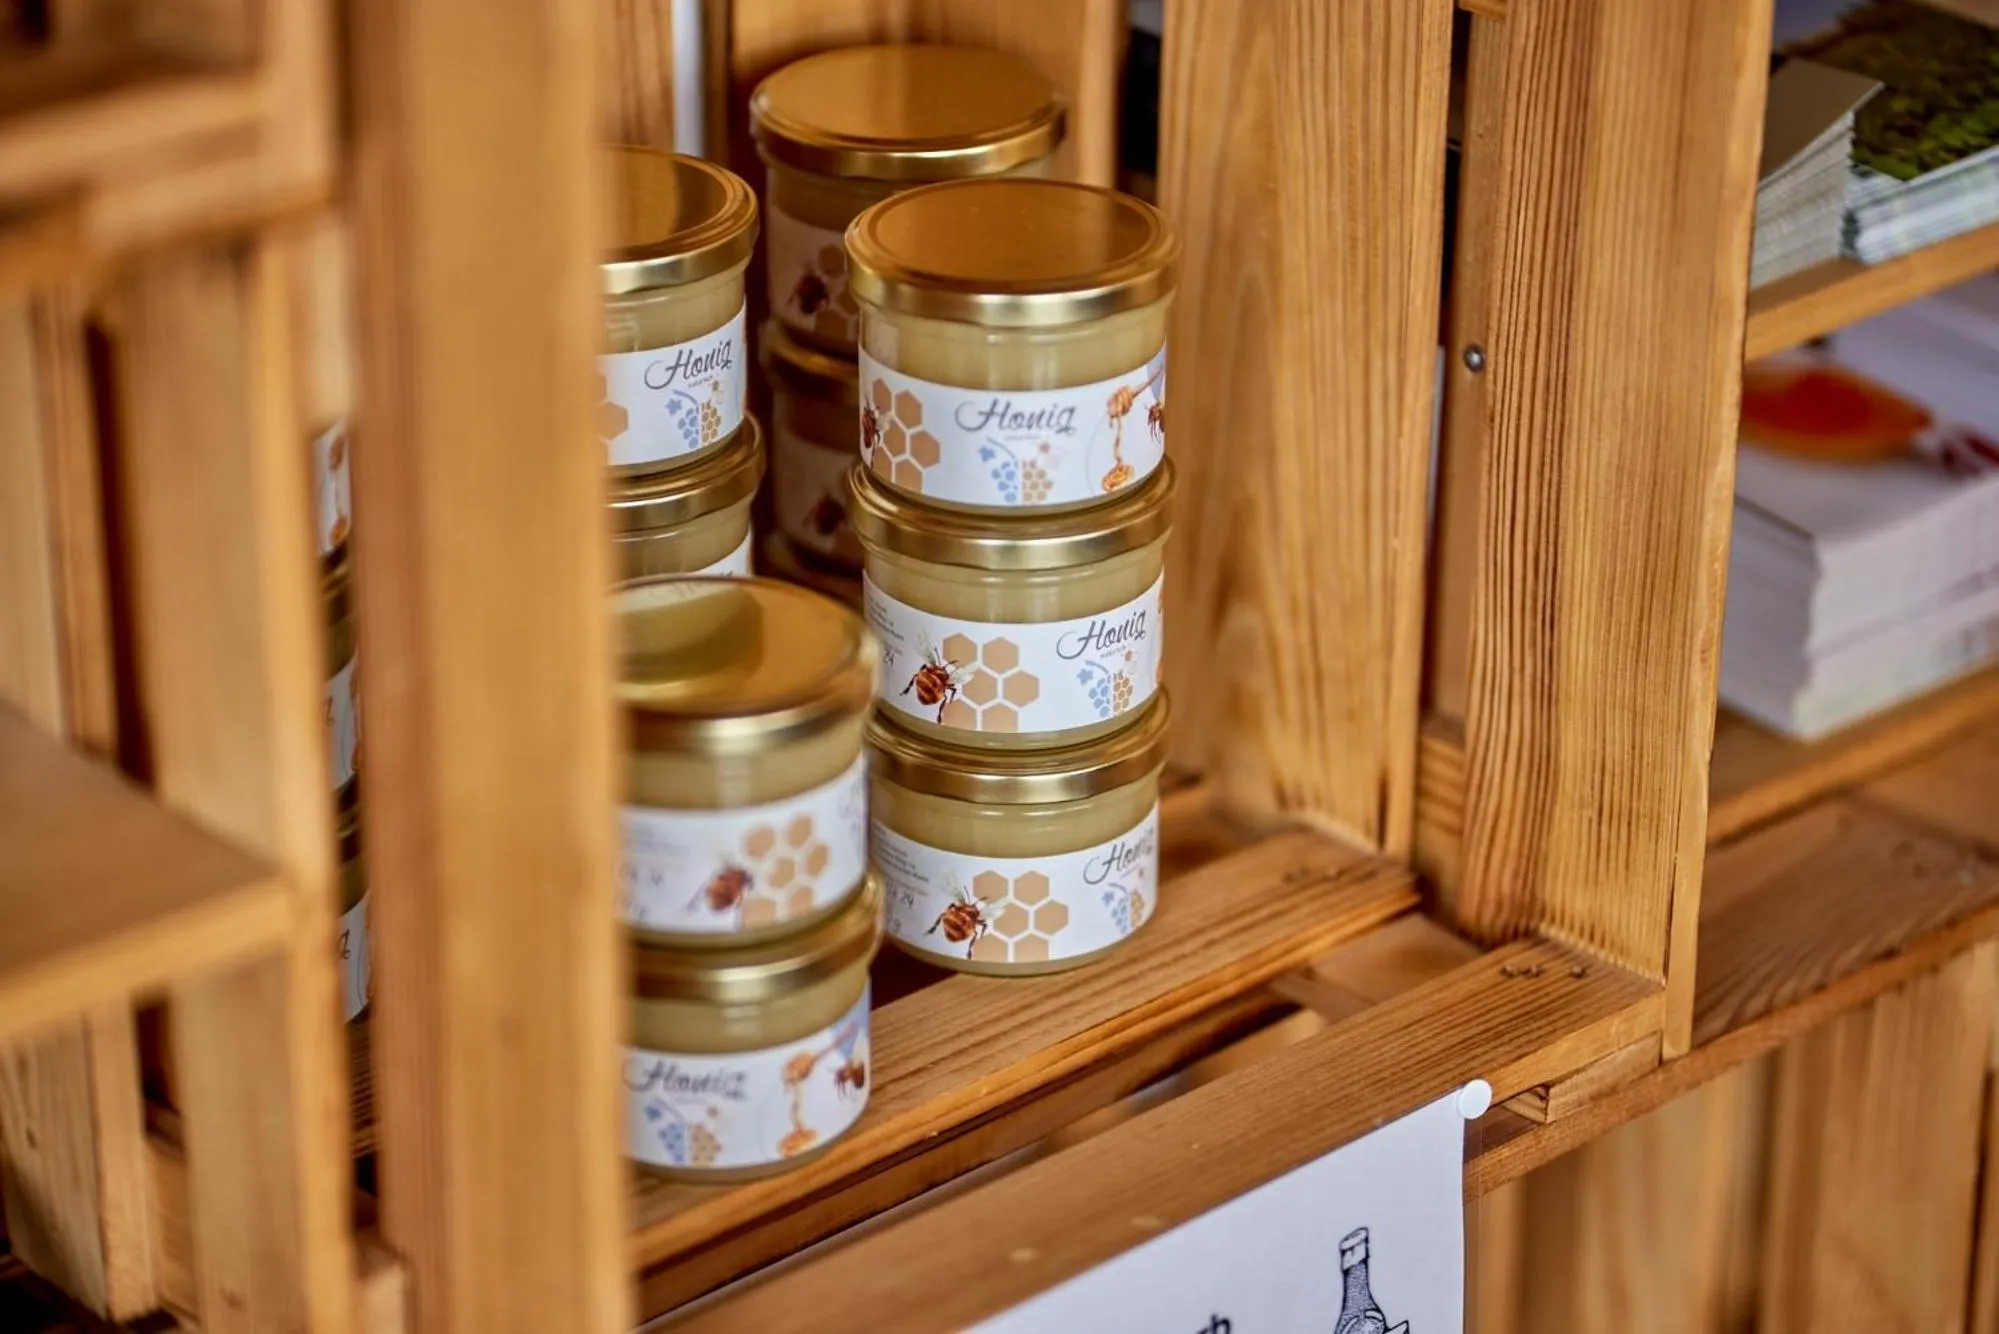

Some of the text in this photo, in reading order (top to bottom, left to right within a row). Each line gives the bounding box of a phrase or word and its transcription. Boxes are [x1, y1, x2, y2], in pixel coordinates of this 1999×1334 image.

[645, 339, 732, 390] Honig
[954, 397, 1077, 434] Honig
[1056, 610, 1147, 660] Honig
[620, 1058, 746, 1101] Honig
